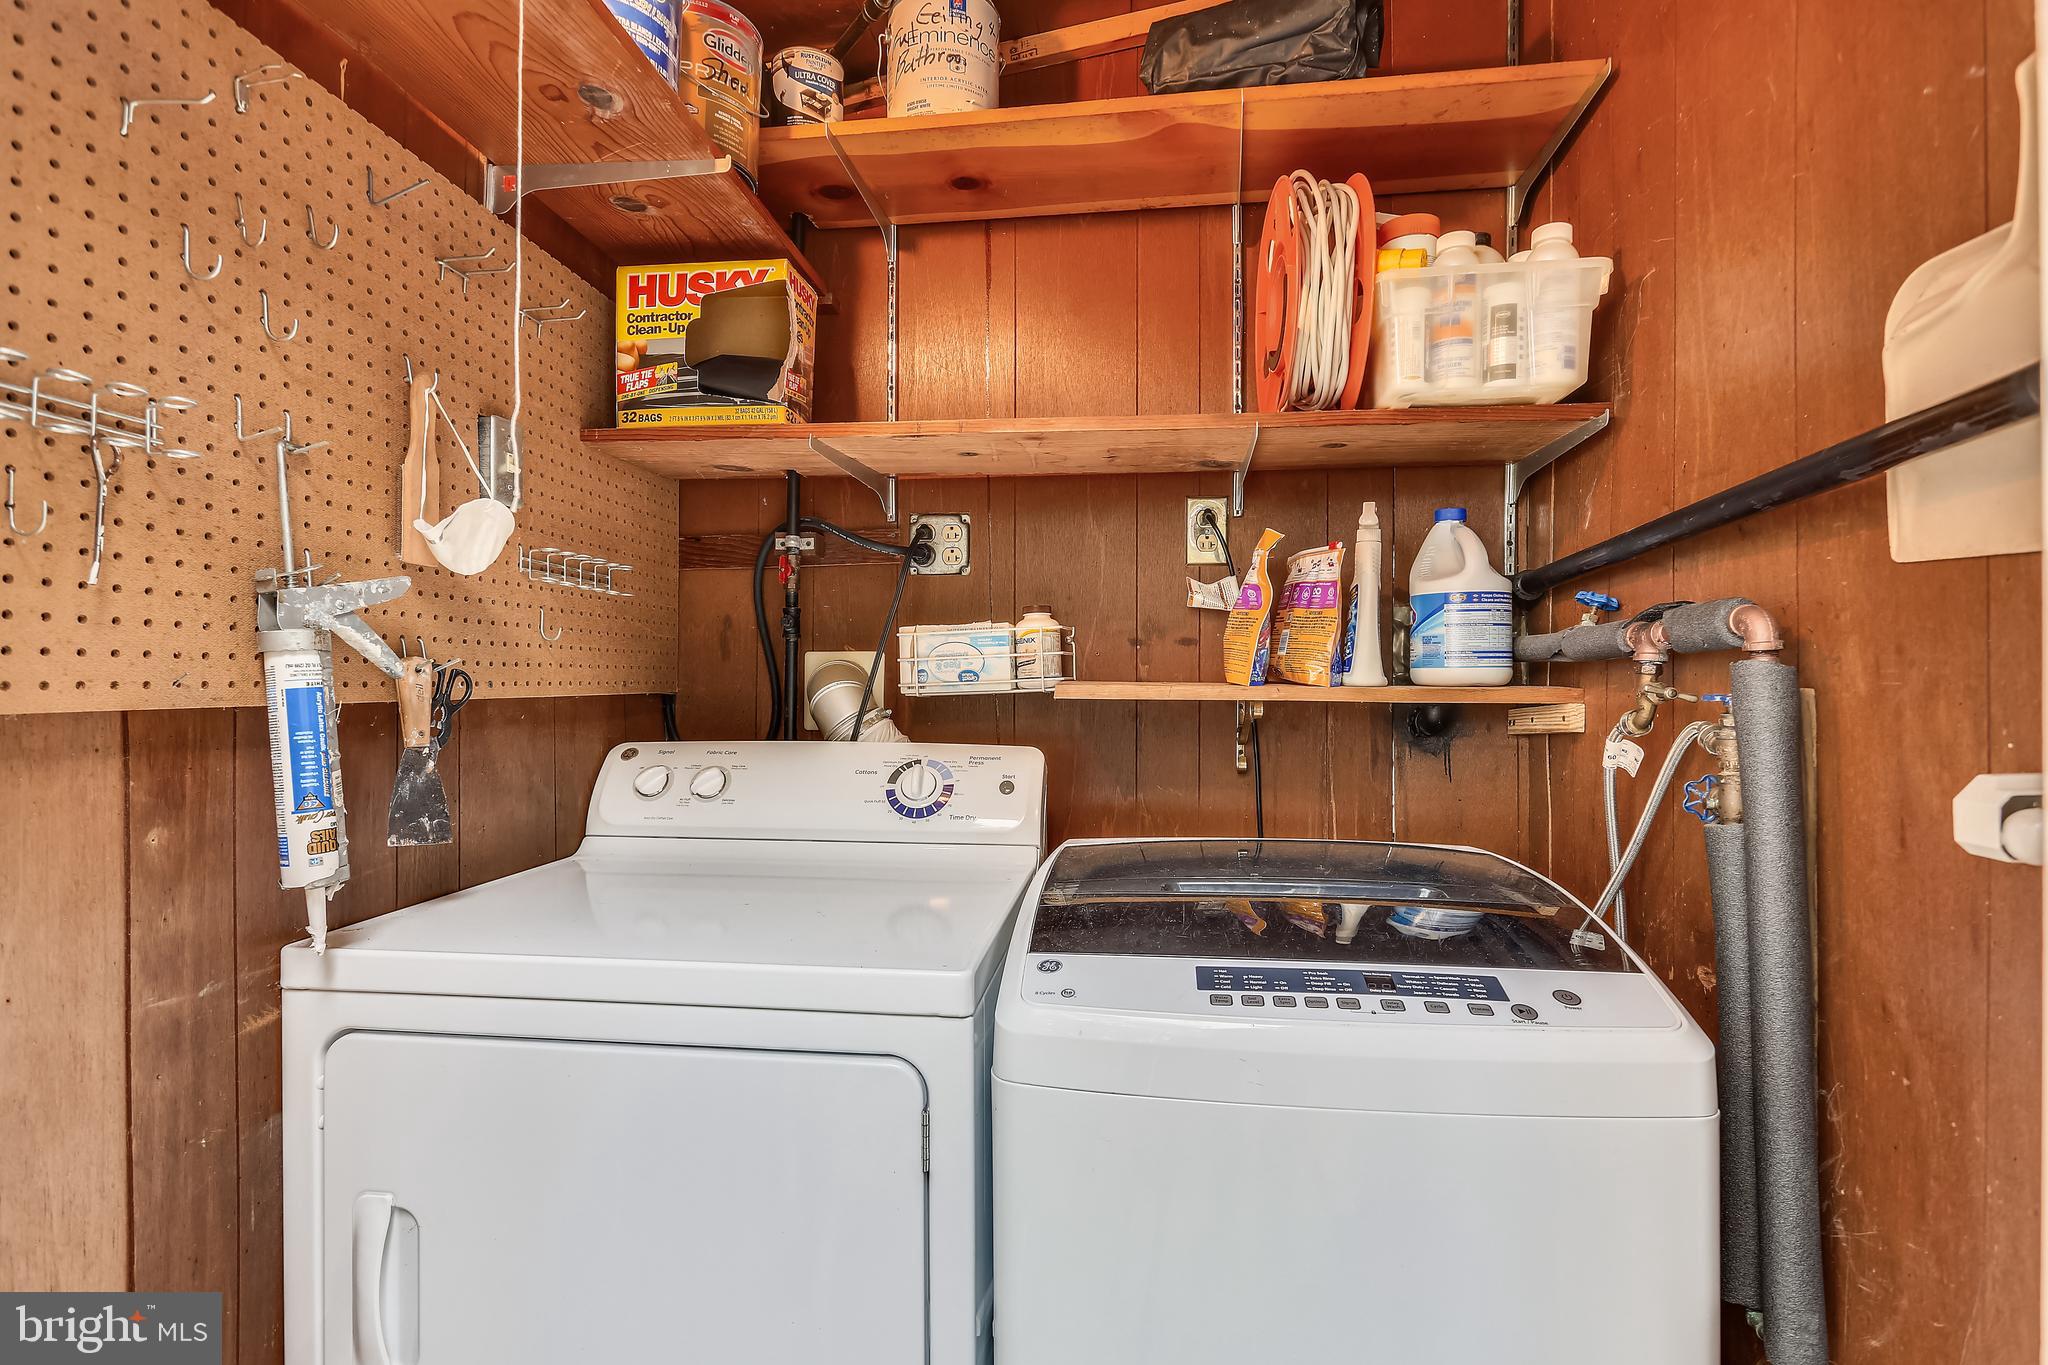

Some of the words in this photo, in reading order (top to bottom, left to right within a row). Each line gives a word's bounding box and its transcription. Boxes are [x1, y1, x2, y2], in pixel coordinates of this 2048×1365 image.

[794, 71, 816, 81] ULTRA
[817, 74, 836, 89] COVER
[789, 269, 814, 314] HUSKY
[626, 311, 693, 324] Contractor
[626, 322, 686, 336] Clean-Up
[620, 371, 640, 384] TRUE
[640, 368, 655, 380] TIE
[625, 378, 649, 392] FLAPS
[621, 411, 637, 424] 32
[638, 413, 663, 423] BAGS
[317, 714, 326, 732] Latex
[319, 733, 327, 752] Caulk
[965, 814, 977, 822] Dry
[310, 828, 337, 843] AILS
[306, 839, 338, 856] QUID
